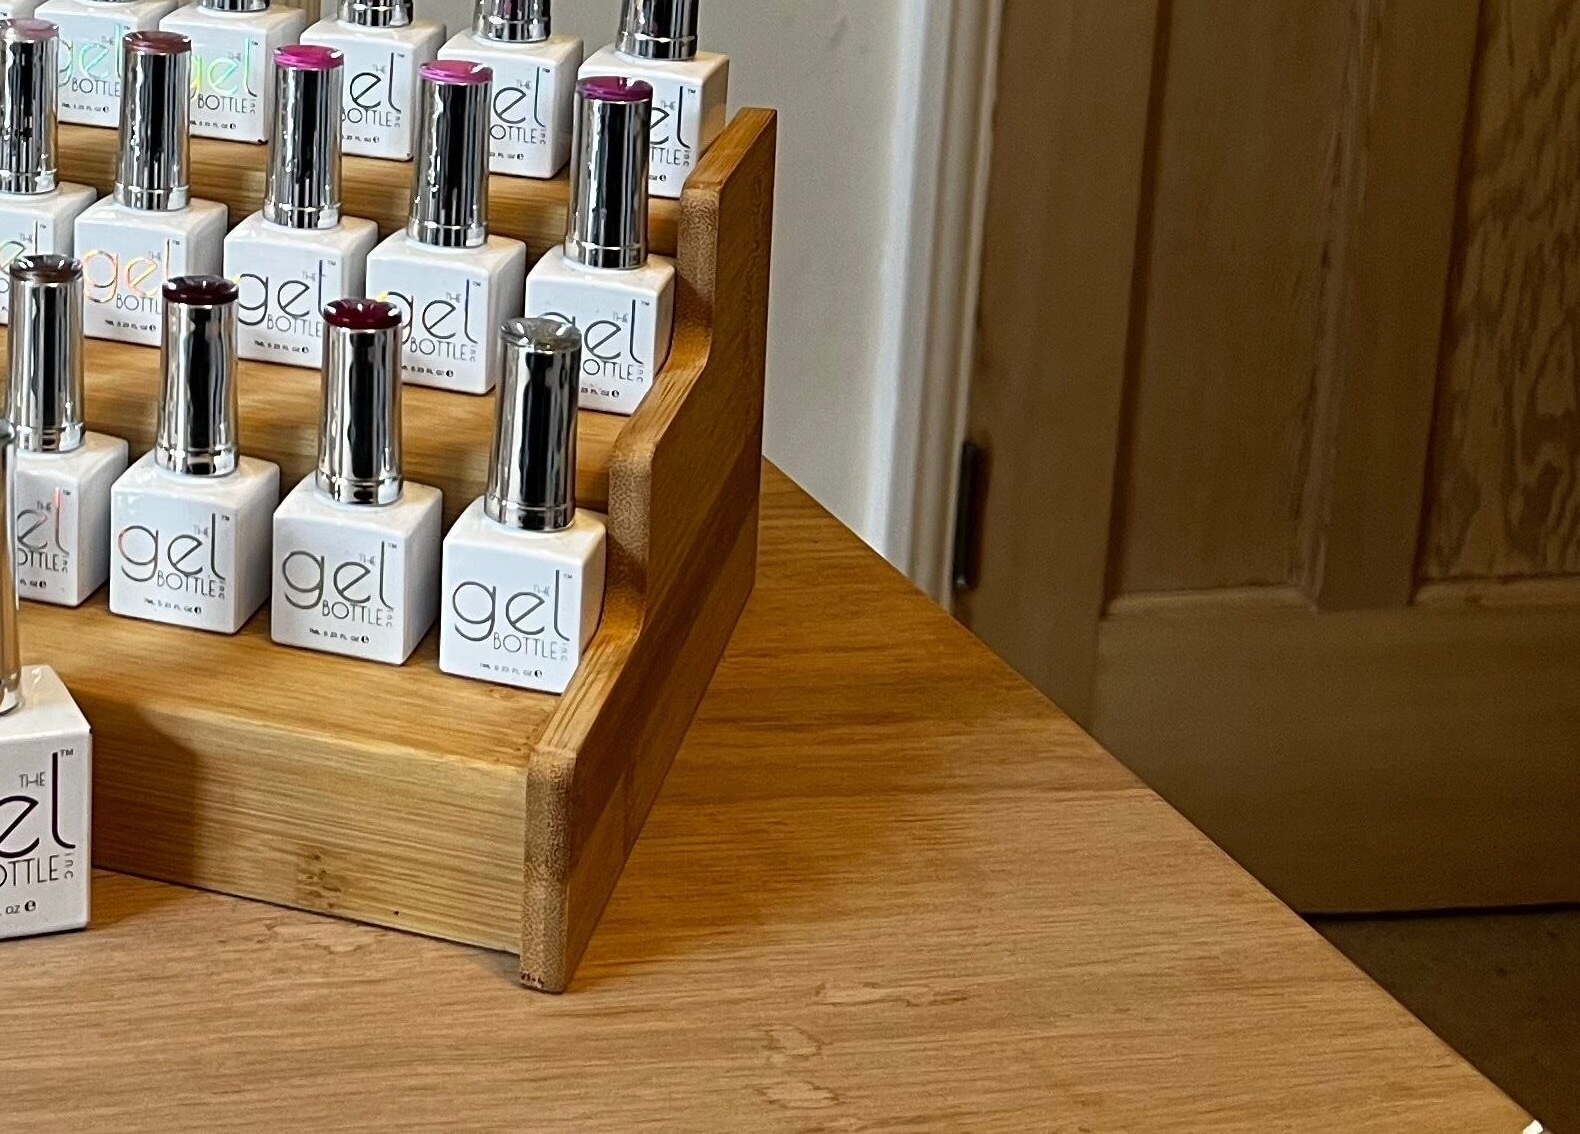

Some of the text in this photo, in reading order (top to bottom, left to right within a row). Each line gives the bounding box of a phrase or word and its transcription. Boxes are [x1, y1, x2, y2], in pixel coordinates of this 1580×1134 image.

[349, 52, 402, 114] el
[493, 67, 546, 128] el
[197, 94, 247, 114] BOTTLE
[490, 124, 537, 145] OTTLE
[116, 293, 162, 315] BOTTL
[238, 259, 324, 326] gel
[410, 336, 467, 362] BOTTLE
[583, 358, 634, 382] OTTLE
[17, 487, 69, 556] el
[118, 513, 226, 582] gel
[157, 569, 216, 598] BOTTLE
[282, 541, 394, 610] gel
[322, 598, 383, 627] BOTTLE
[452, 569, 571, 642] gel
[493, 631, 559, 661] BOTTLE
[19, 772, 45, 788] THE
[4, 904, 21, 915] OZ
